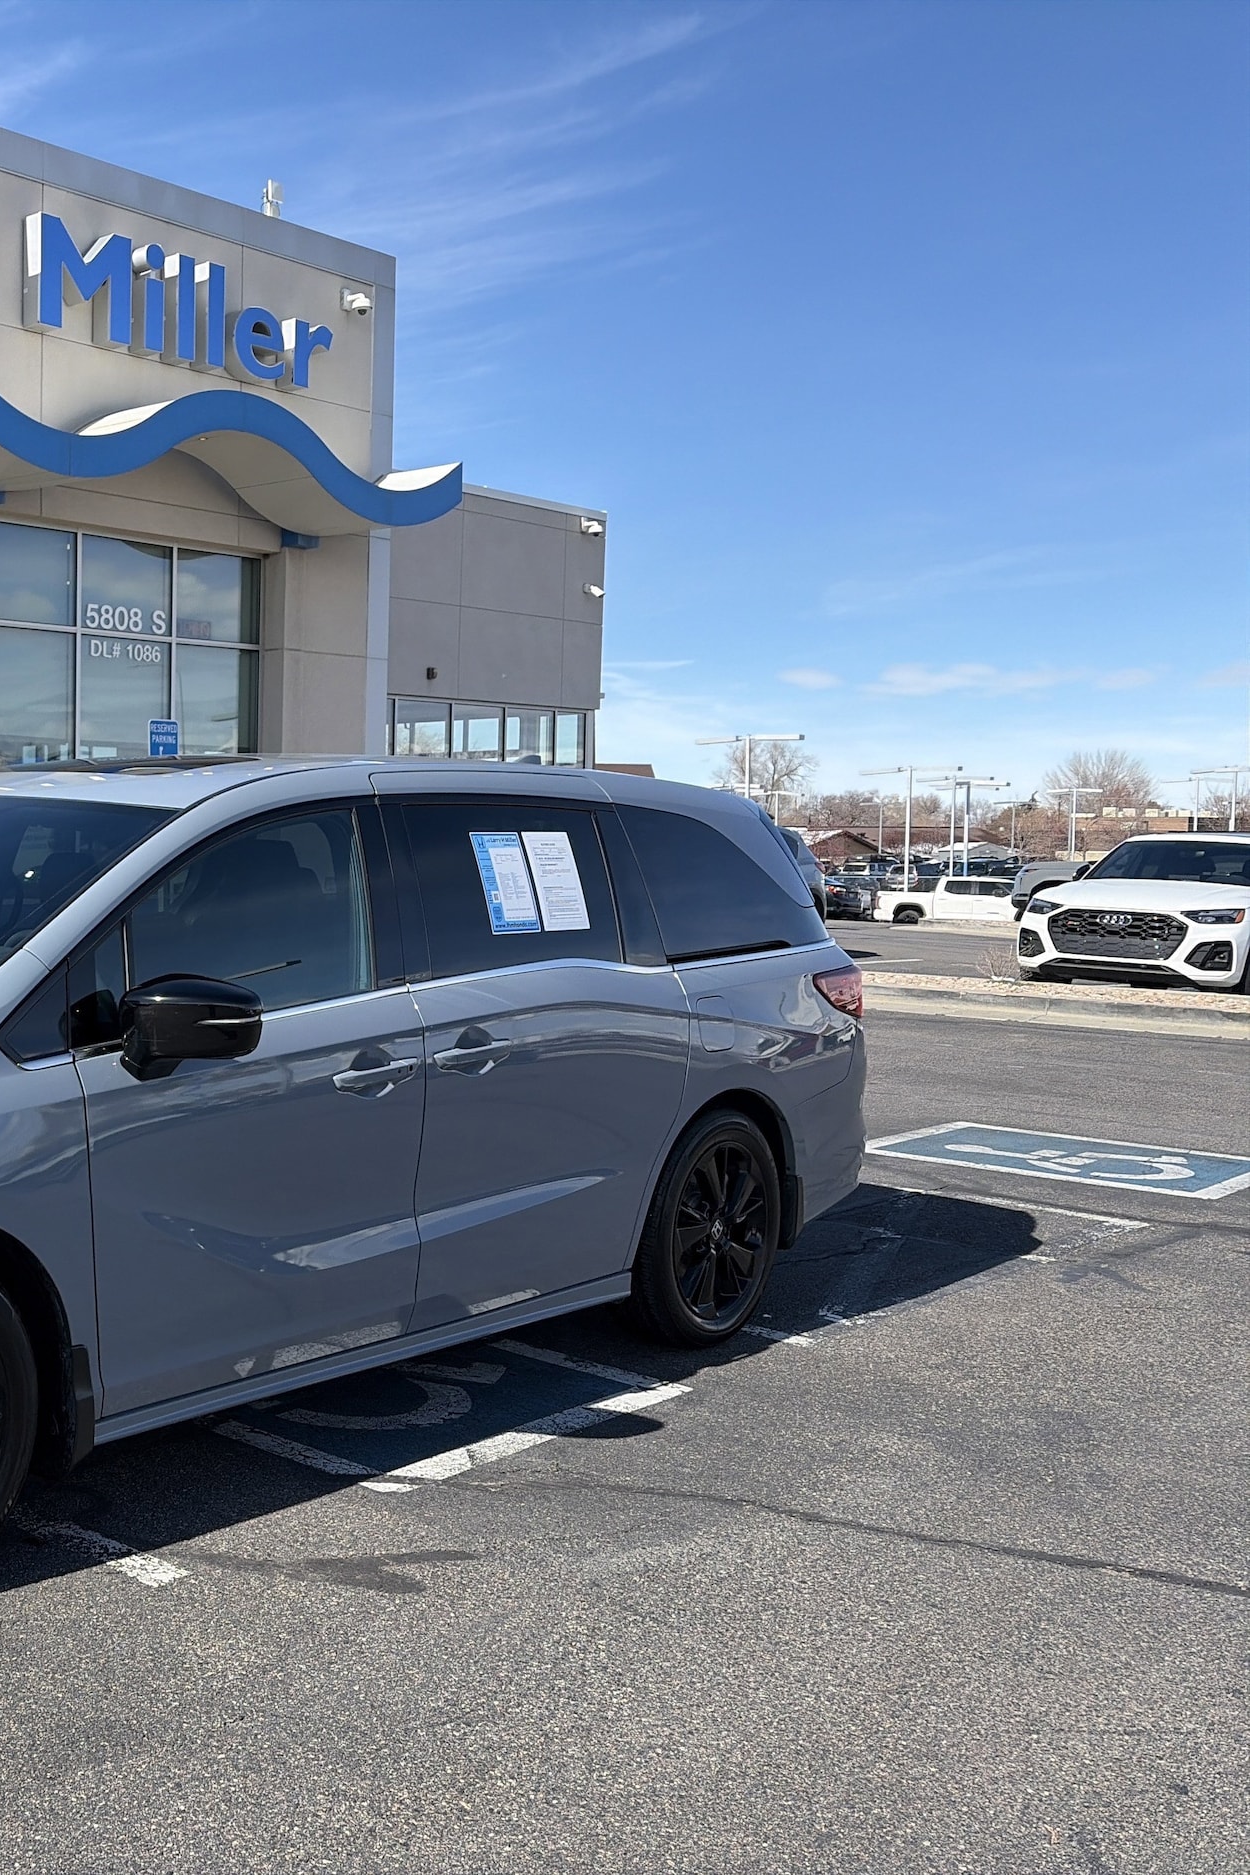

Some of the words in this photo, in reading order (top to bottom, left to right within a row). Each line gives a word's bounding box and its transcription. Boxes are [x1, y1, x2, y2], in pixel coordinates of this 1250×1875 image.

[23, 210, 334, 390] Miller
[85, 603, 143, 632] 5808
[151, 609, 166, 635] S
[90, 639, 122, 659] DL#
[126, 643, 162, 663] 1086
[150, 723, 178, 733] RESERVED
[151, 734, 177, 744] PARKING
